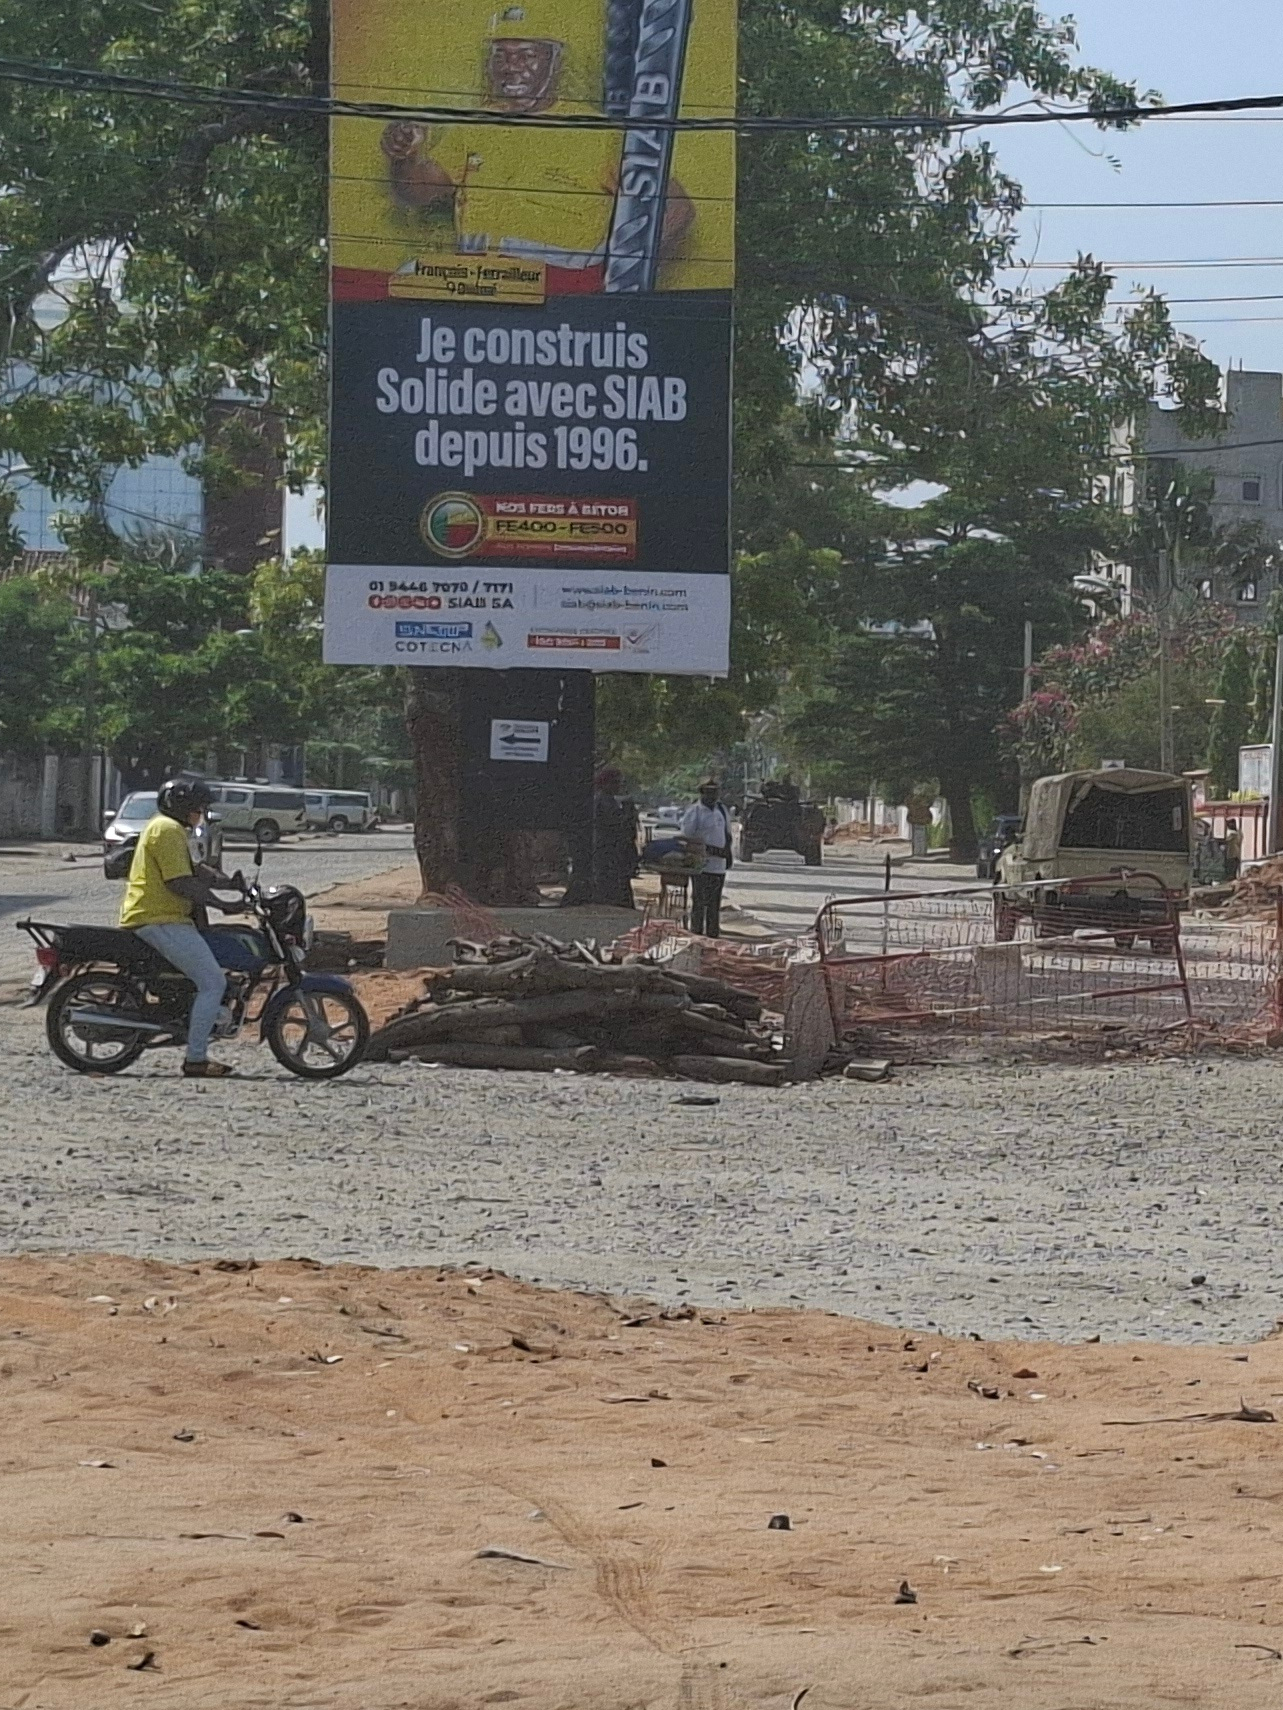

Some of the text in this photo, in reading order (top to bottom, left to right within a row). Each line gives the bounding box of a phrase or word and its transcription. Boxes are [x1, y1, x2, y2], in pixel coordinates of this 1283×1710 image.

[621, 73, 670, 202] SIAB
[416, 317, 648, 369] Je construis
[376, 367, 687, 421] Solide avec SIAB
[415, 419, 648, 476] depuis 1996.
[369, 581, 385, 592] 01
